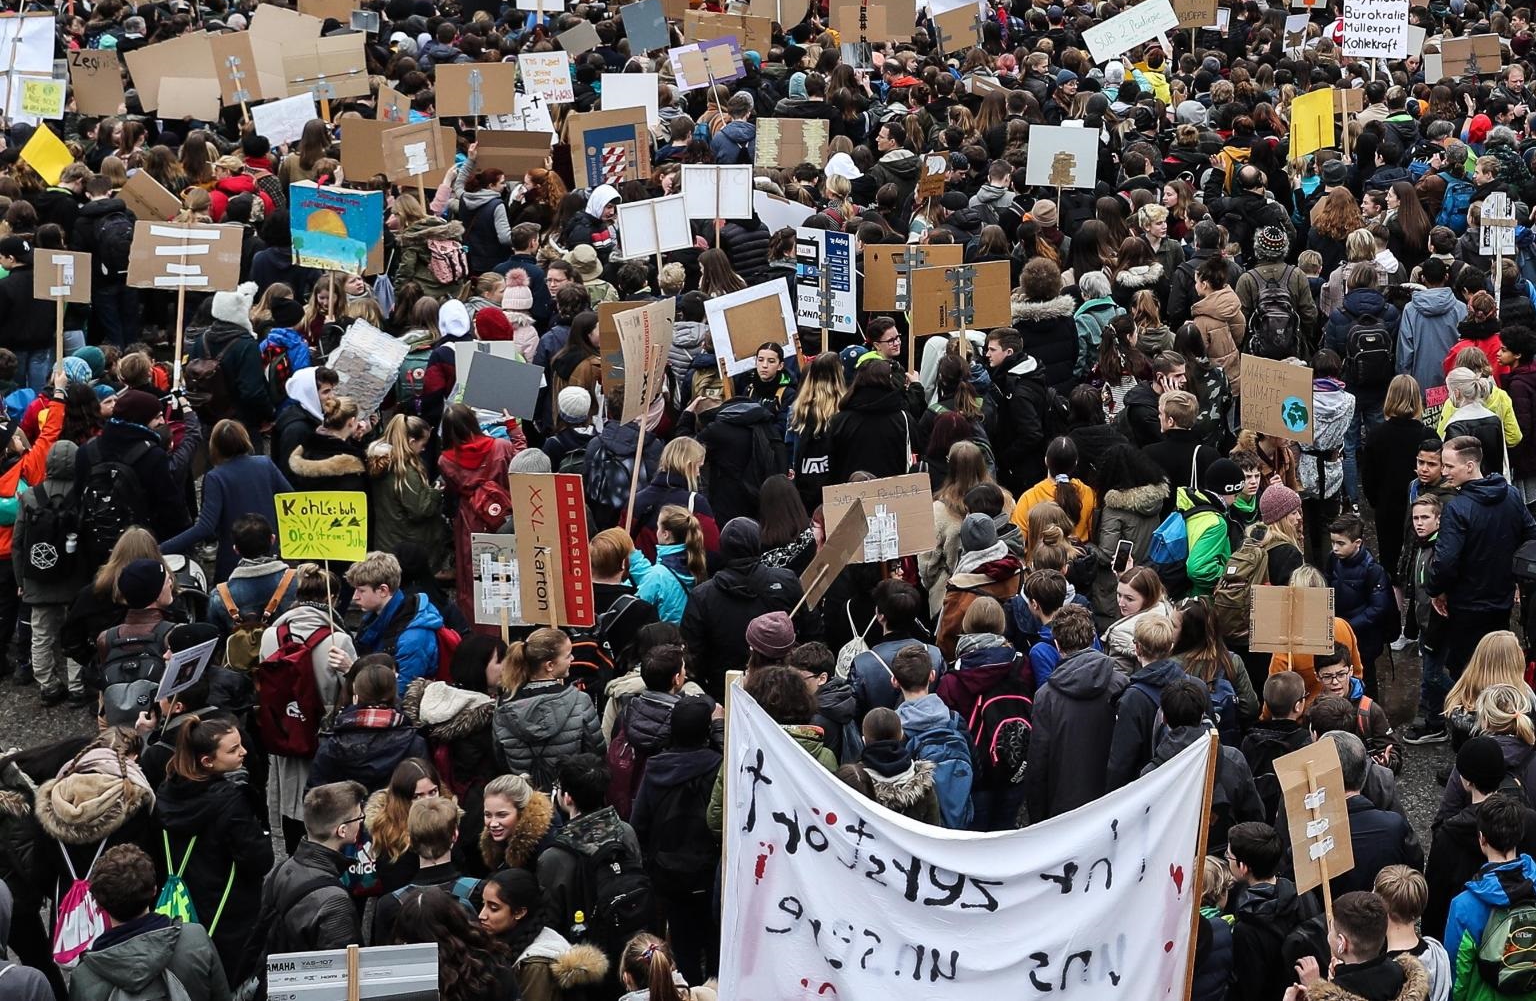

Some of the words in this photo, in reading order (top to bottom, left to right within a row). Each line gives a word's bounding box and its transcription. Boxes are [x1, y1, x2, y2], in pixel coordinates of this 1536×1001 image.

[1345, 6, 1406, 20] Bürokratie
[1344, 22, 1401, 36] Müllexport
[1343, 37, 1398, 53] Kohlekraft
[1245, 368, 1271, 384] MAKE
[1243, 383, 1281, 400] CLIMATE
[1243, 400, 1272, 418] GREAT
[569, 524, 582, 578] BASIC
